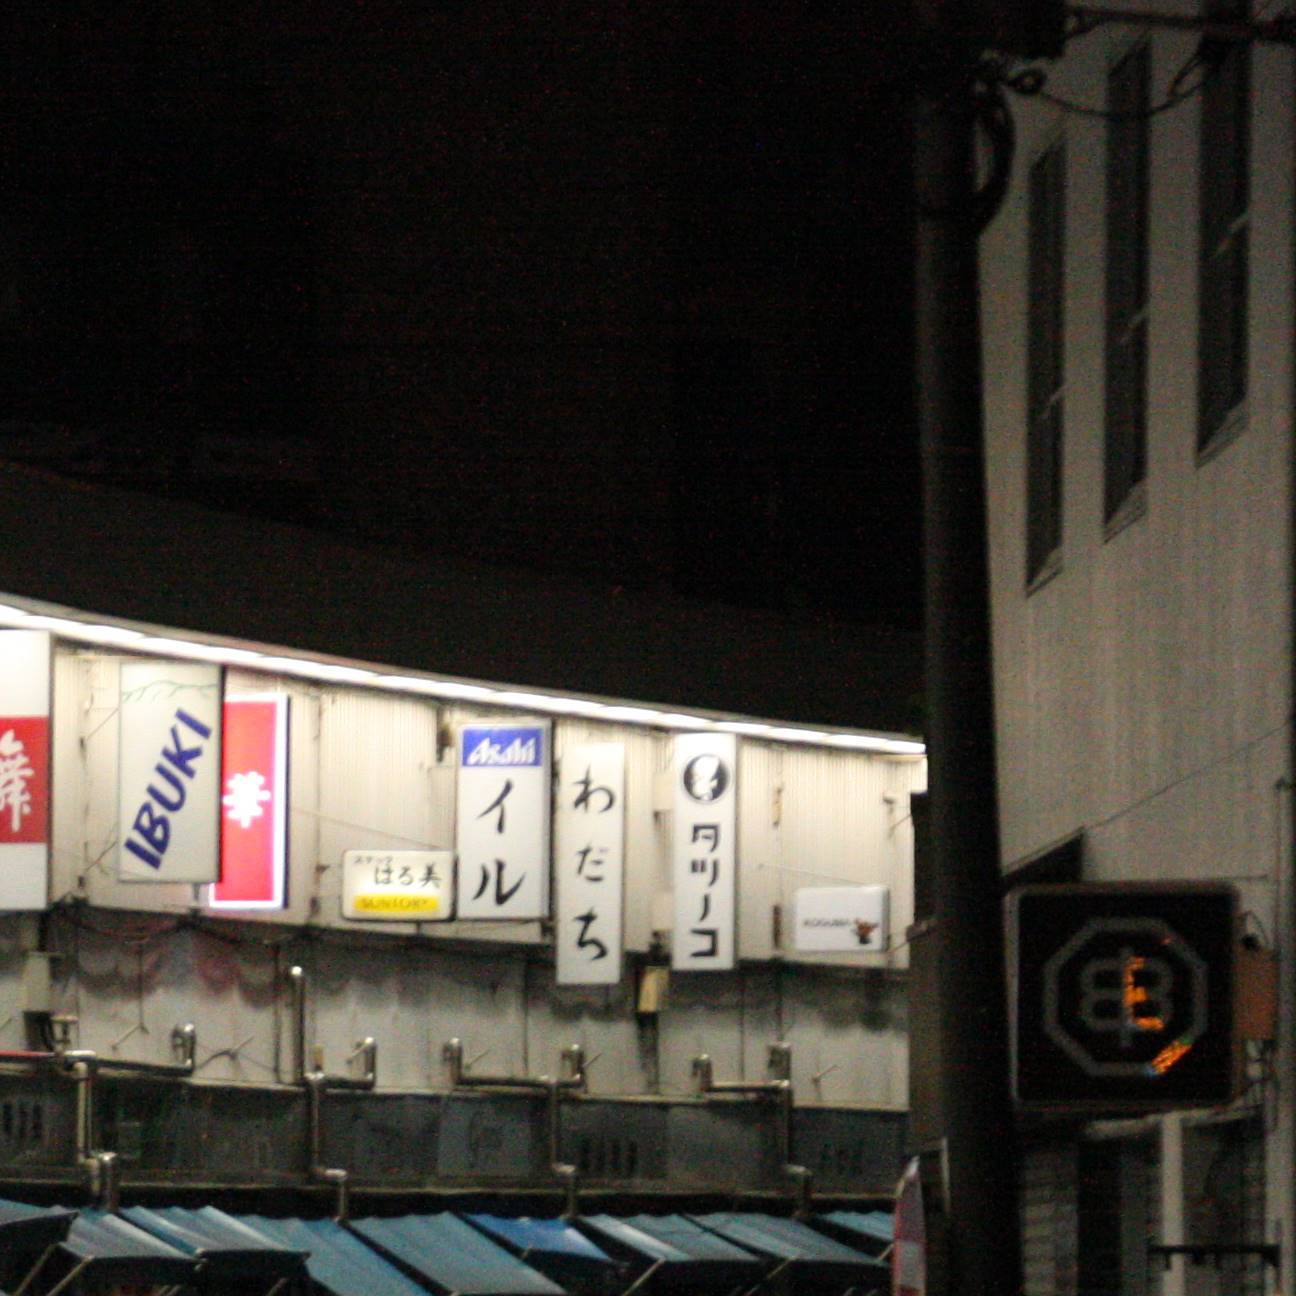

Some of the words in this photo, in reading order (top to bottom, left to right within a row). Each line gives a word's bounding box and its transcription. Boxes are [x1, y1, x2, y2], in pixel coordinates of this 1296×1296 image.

[123, 707, 213, 870] IBUKI
[466, 736, 537, 765] Asahi
[473, 777, 526, 907] イル
[572, 763, 616, 961] わだち
[690, 823, 720, 958] タツノコ
